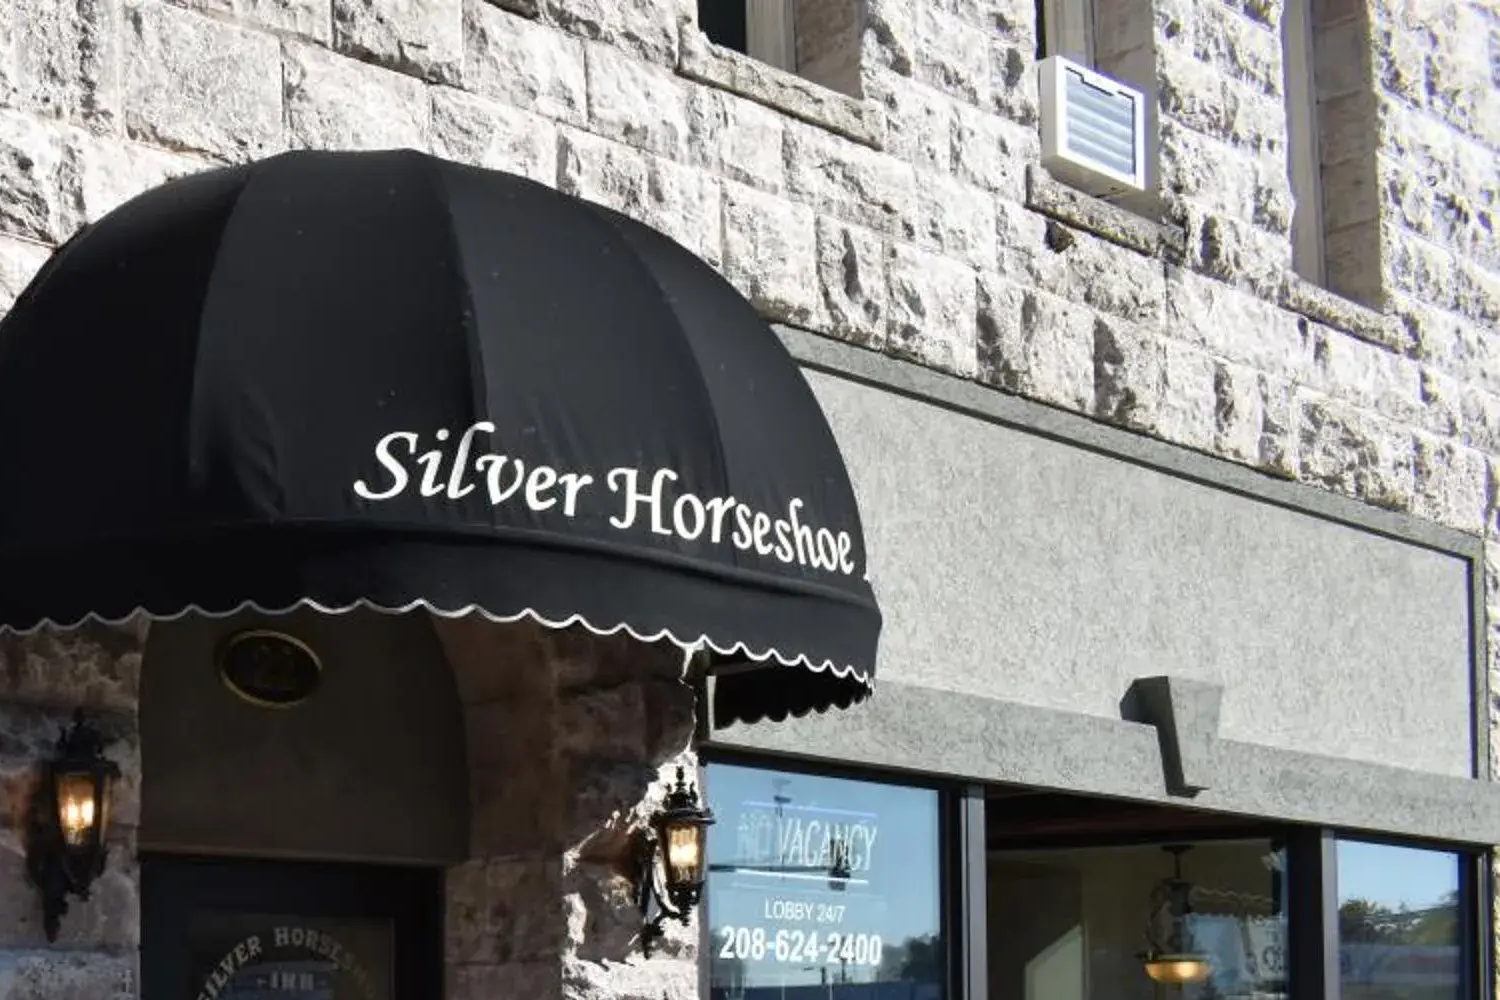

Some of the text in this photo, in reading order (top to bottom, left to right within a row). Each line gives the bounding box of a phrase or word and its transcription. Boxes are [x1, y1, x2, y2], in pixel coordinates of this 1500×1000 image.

[352, 421, 854, 574] Silver Horseshoe
[776, 816, 878, 871] VACANCY
[764, 898, 846, 922] LOBBY 24/7
[719, 926, 883, 965] 208-624-2400
